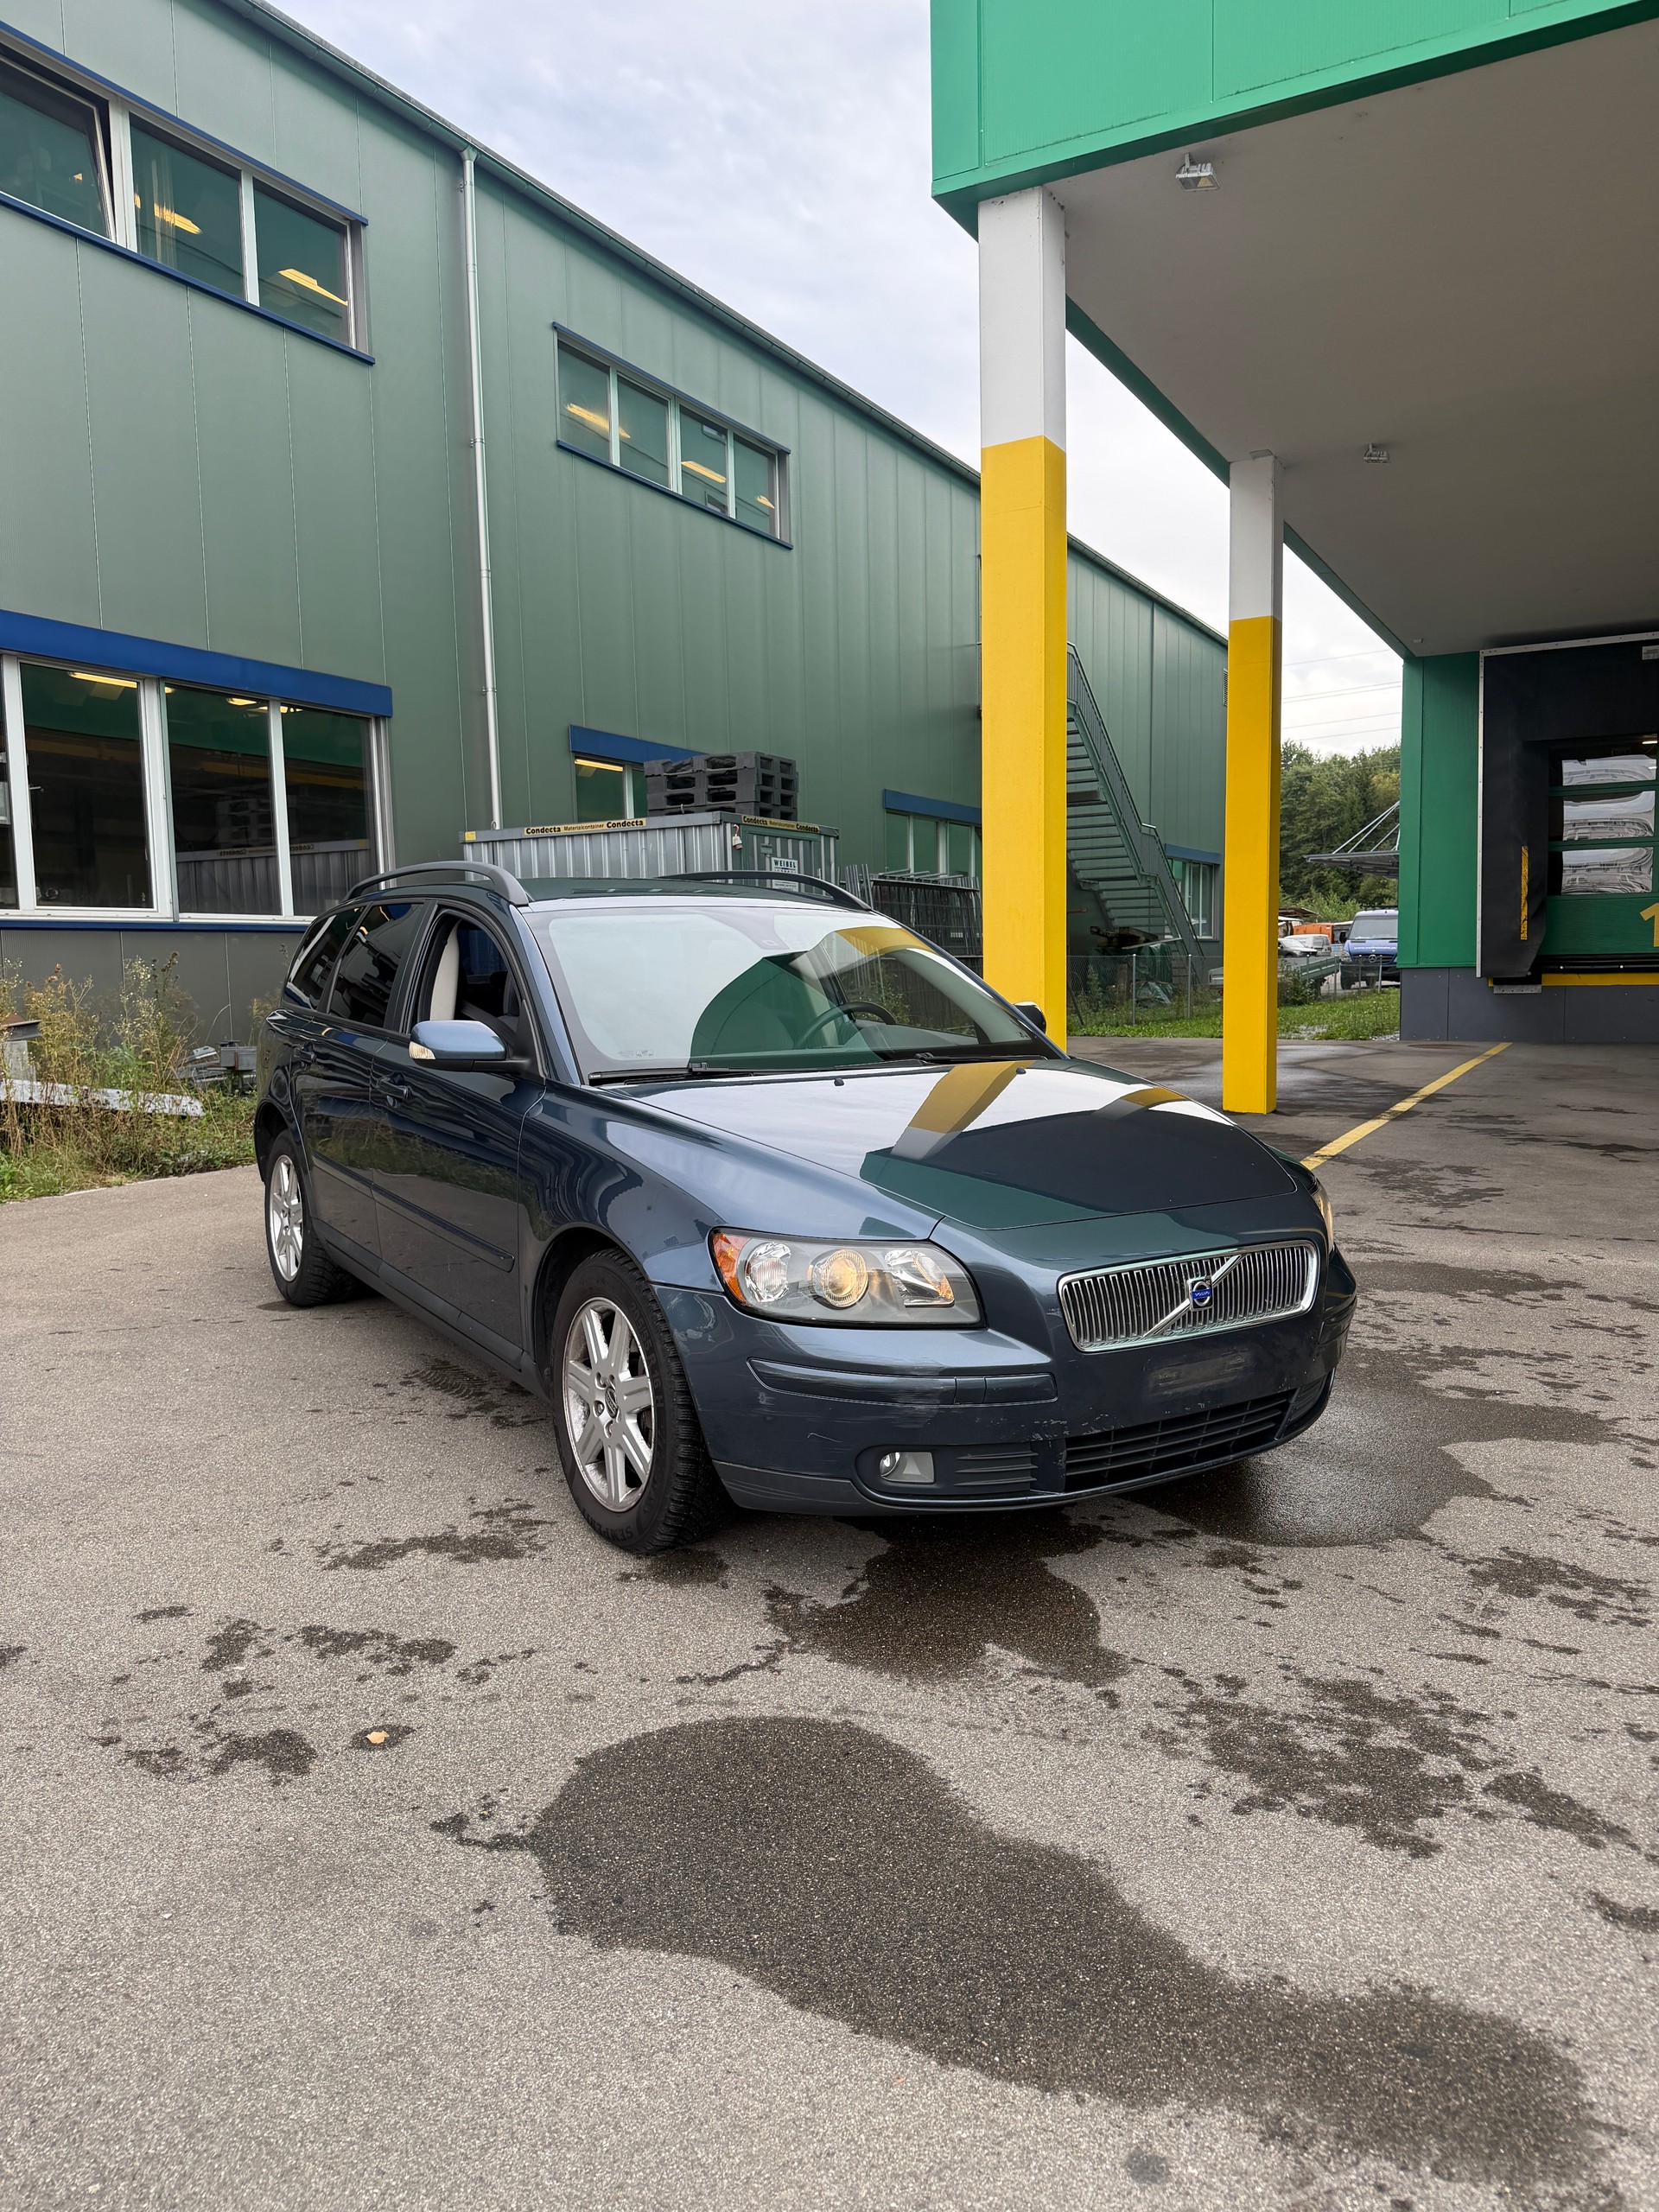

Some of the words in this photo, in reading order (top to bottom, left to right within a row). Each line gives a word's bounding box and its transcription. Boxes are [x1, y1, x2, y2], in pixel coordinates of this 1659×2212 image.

[606, 819, 644, 829] Condecta
[743, 817, 767, 825] Condecta
[796, 823, 819, 832] Condecta
[774, 859, 797, 868] WEIBEL
[630, 1301, 652, 1351] 205/55
[648, 1354, 657, 1367] R
[652, 1371, 662, 1389] 16
